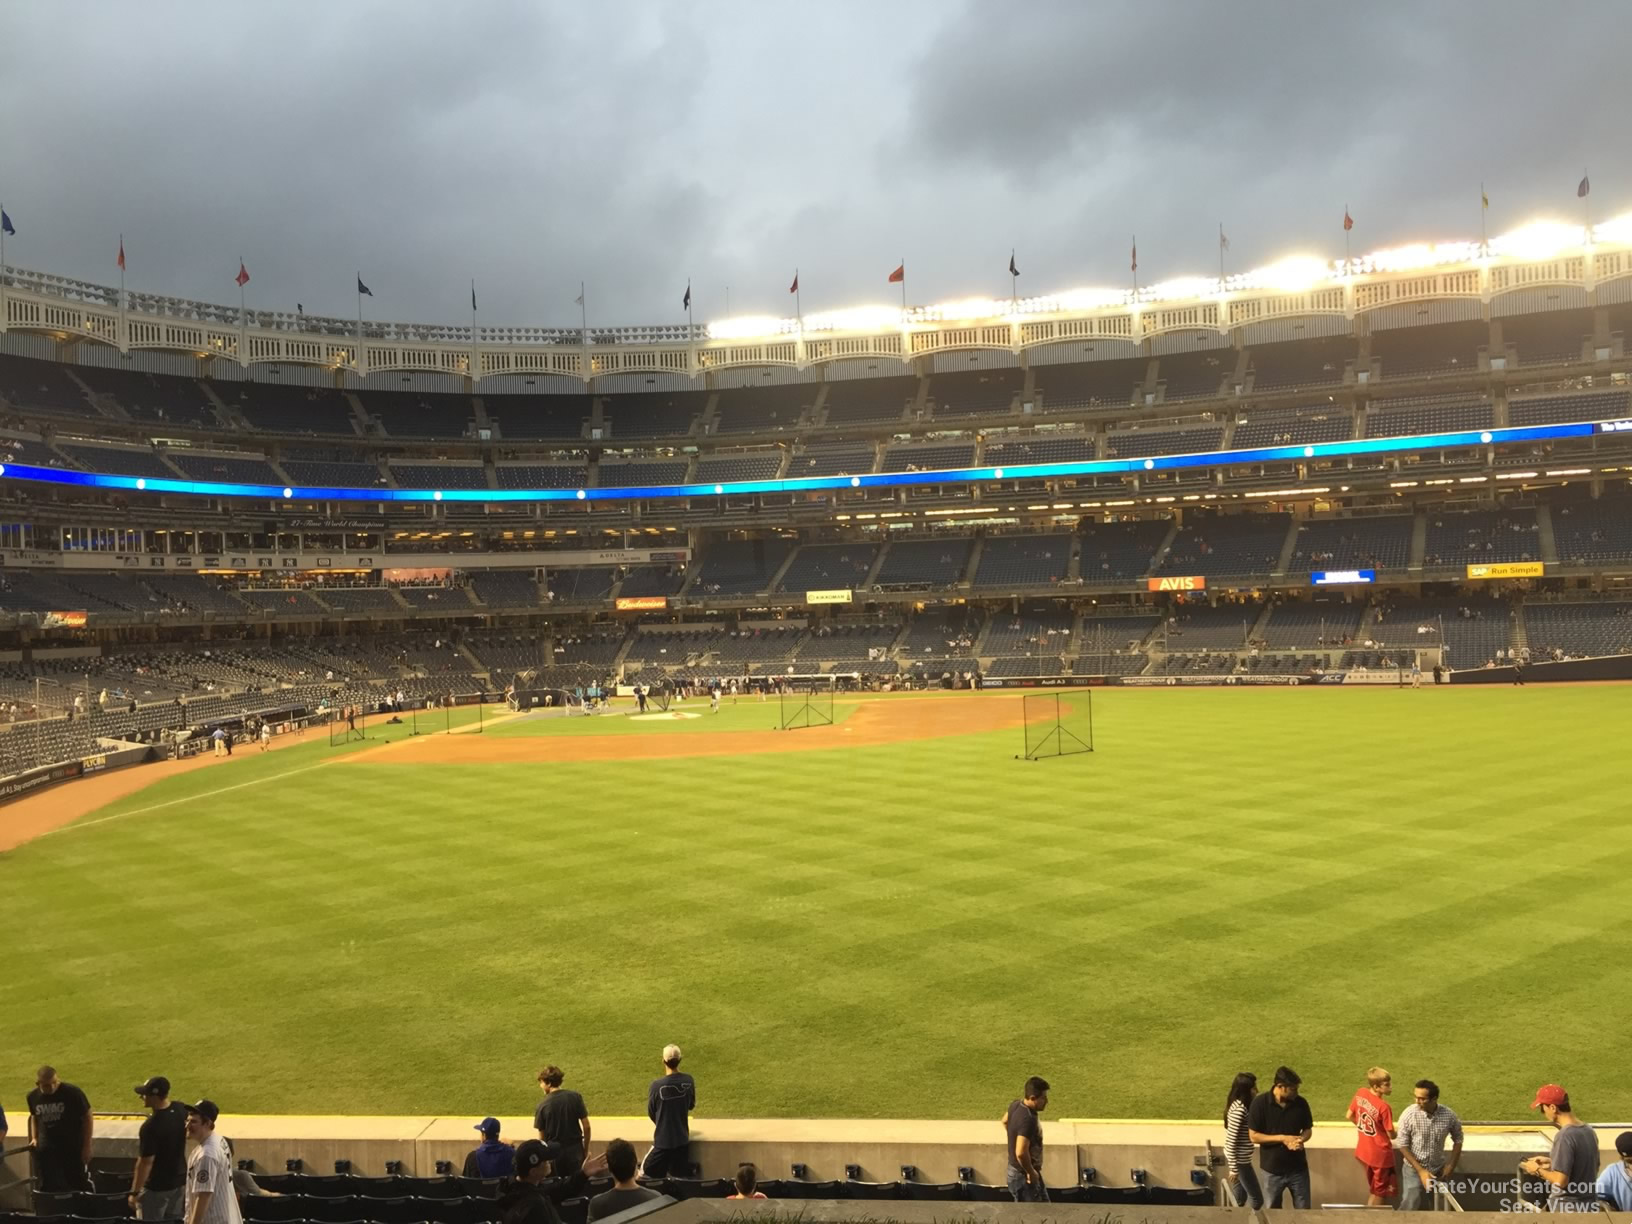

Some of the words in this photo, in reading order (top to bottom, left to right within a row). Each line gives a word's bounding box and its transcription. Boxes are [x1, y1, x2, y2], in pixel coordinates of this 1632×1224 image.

[324, 519, 348, 528] World
[1491, 567, 1508, 575] Run
[1510, 566, 1538, 575] Simple
[1159, 577, 1195, 591] AVIS
[616, 599, 666, 610] Budweiser
[1319, 675, 1342, 683] ACC
[35, 1102, 65, 1116] SWAG
[1356, 1107, 1378, 1137] 13
